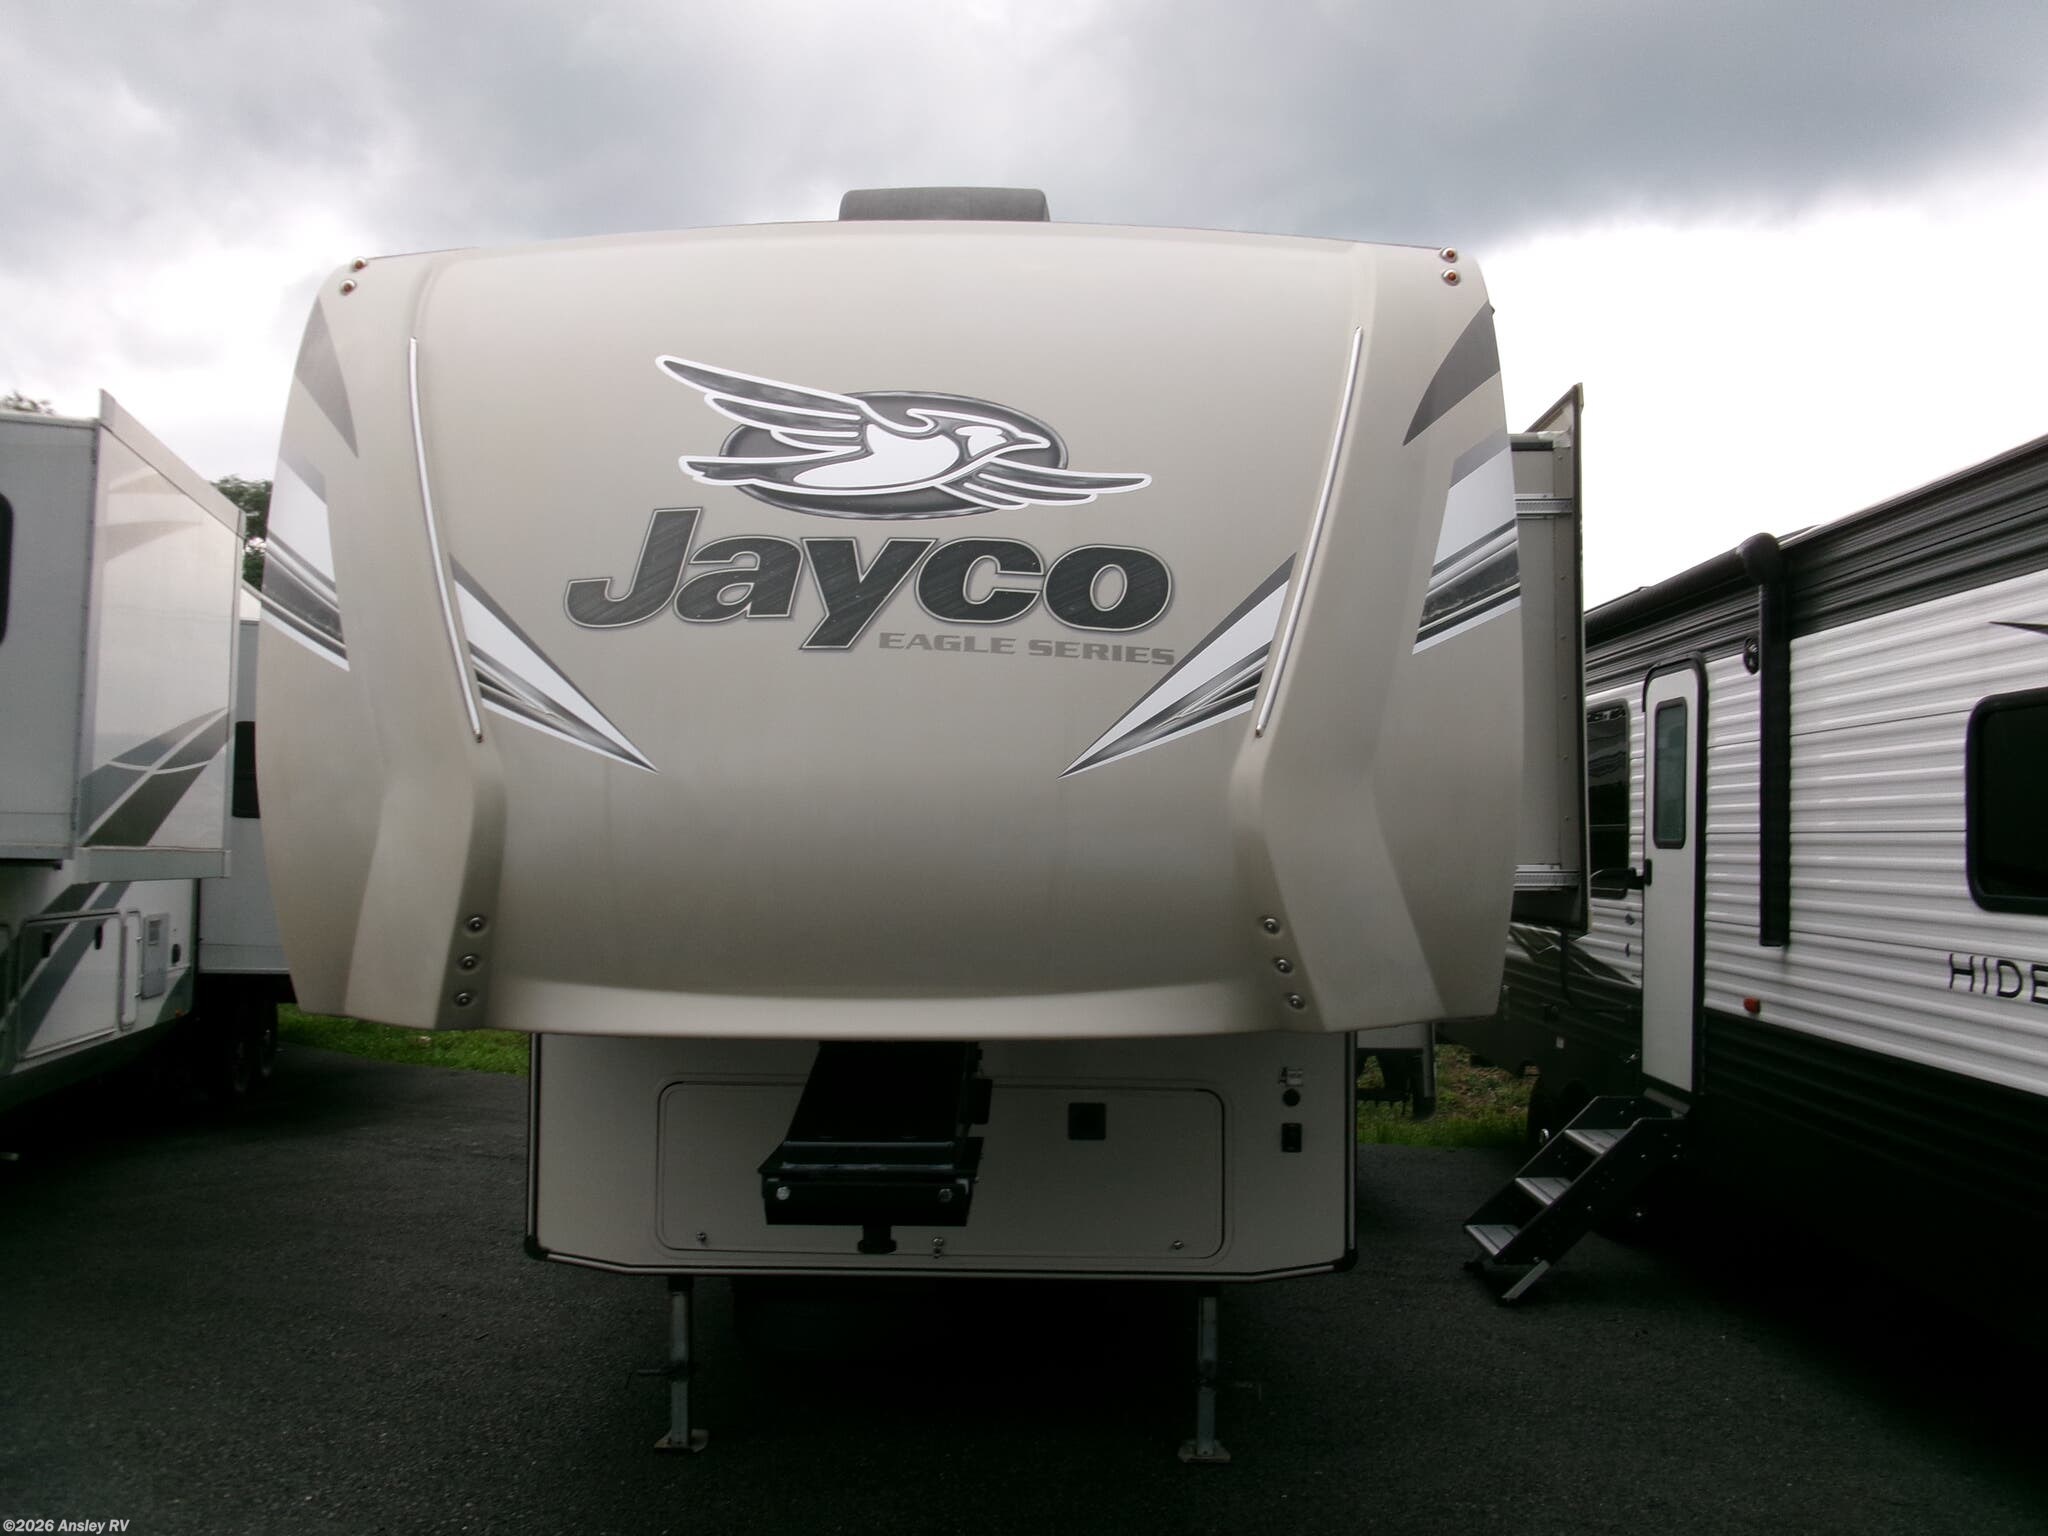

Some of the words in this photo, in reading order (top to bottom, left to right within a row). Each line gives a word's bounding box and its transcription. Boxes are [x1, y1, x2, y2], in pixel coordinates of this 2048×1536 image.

[564, 506, 1175, 652] Jayco
[879, 632, 1017, 655] EAGLE
[1028, 639, 1175, 665] SERIES
